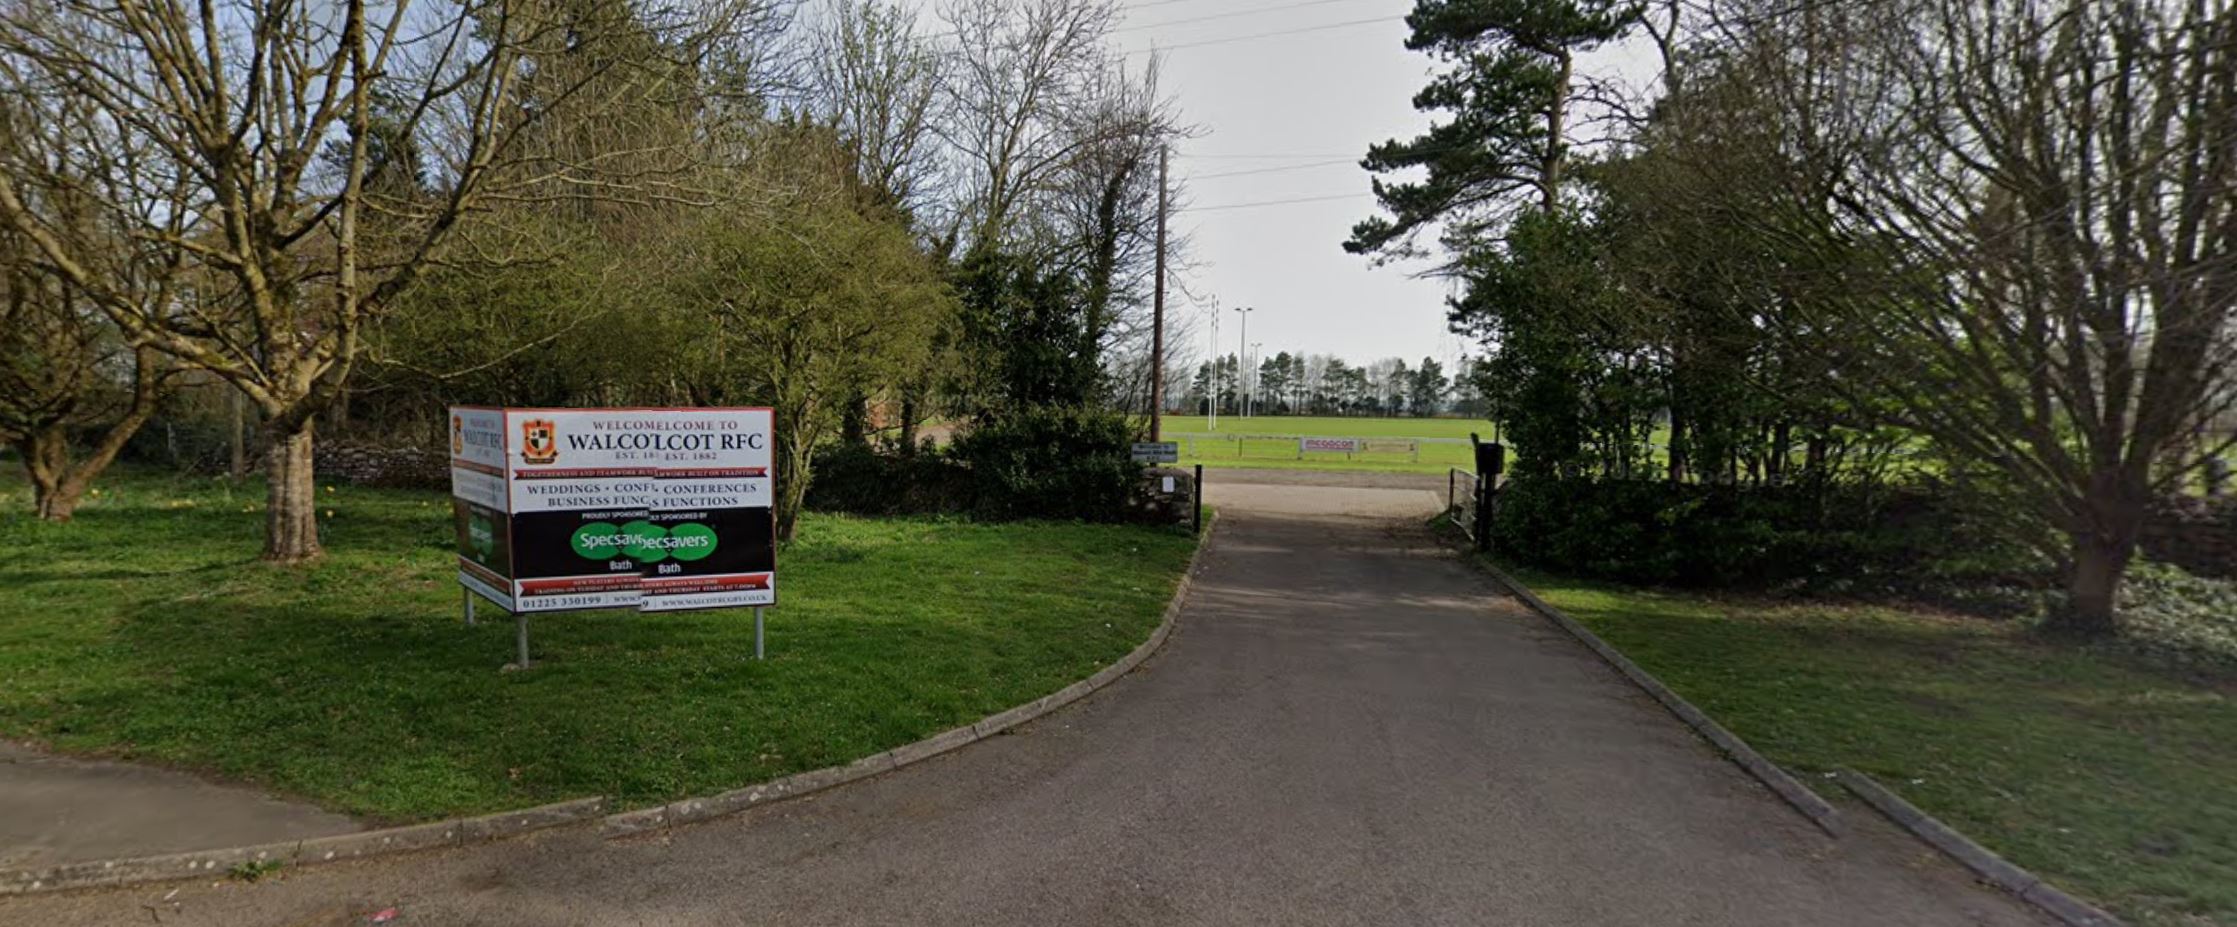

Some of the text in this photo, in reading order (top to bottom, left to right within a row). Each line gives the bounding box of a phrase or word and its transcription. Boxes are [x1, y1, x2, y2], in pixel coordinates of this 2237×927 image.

[719, 420, 738, 430] TO
[720, 432, 763, 450] RFC
[527, 484, 601, 494] WEDDINGS
[663, 483, 757, 494] CONFERENCES
[547, 496, 610, 506] BUSINESS
[663, 496, 738, 507] FUNCTIONS
[609, 560, 633, 570] Bath
[658, 563, 681, 574] Bath
[523, 598, 557, 608] 01225
